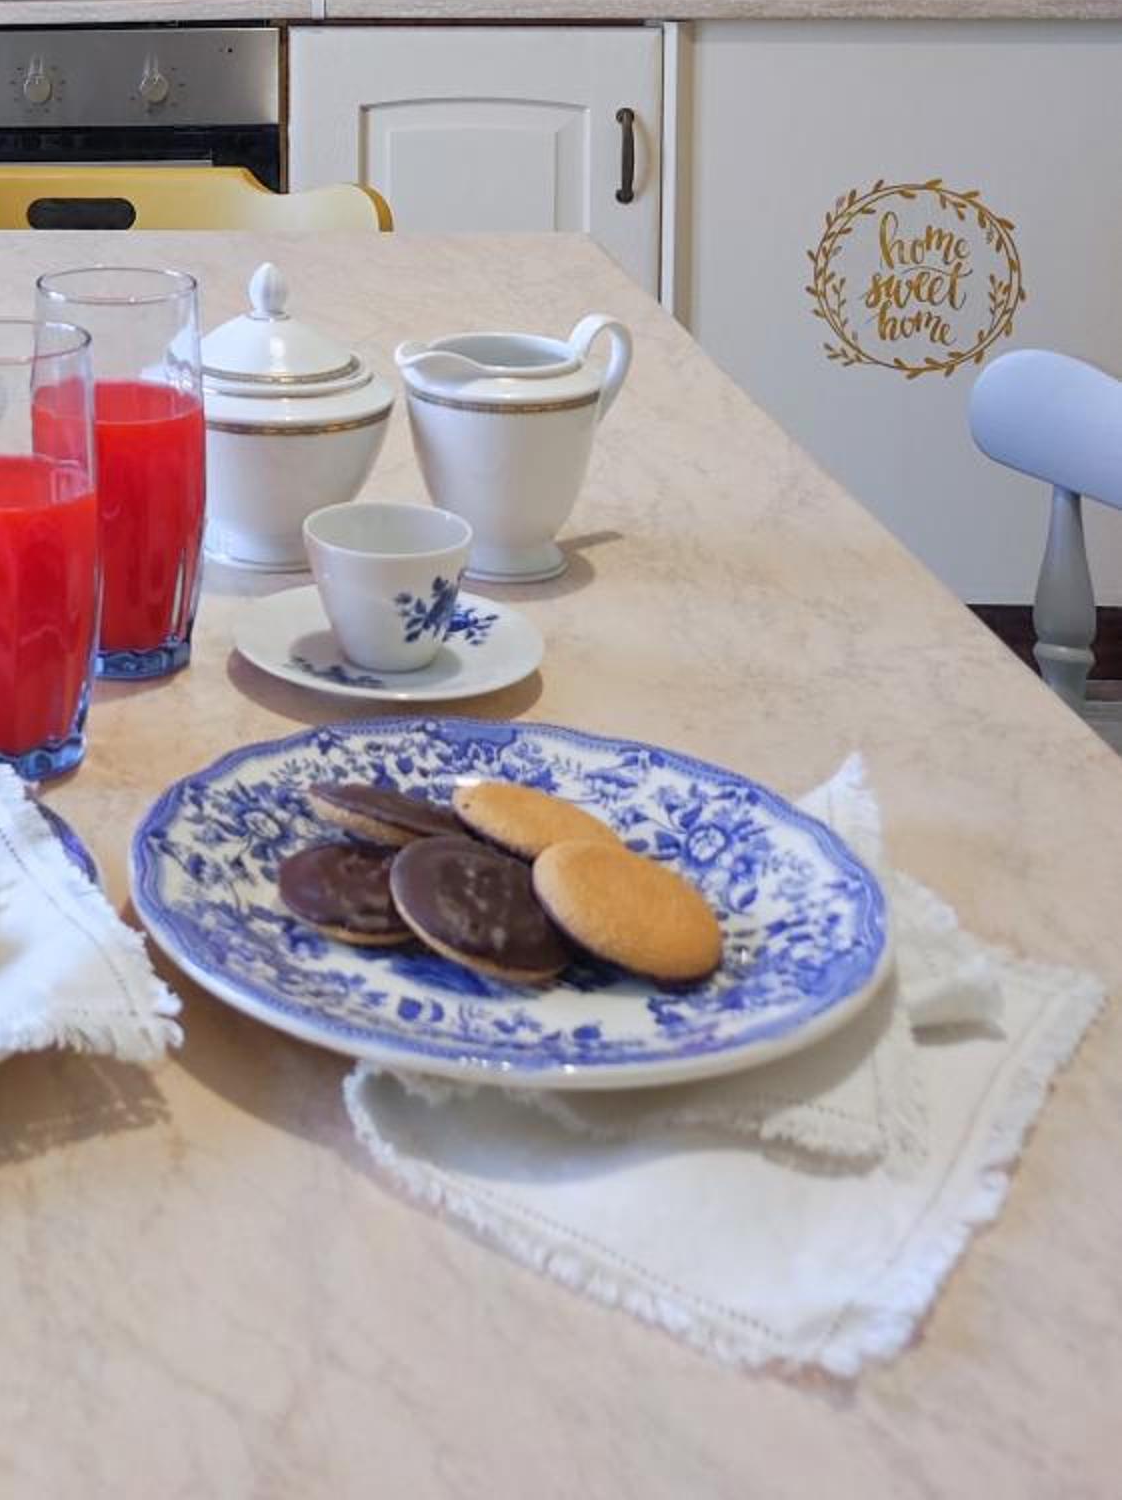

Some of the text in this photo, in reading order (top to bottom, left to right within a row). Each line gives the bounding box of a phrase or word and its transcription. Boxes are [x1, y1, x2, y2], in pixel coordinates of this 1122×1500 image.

[879, 211, 972, 269] home
[862, 262, 971, 310] sweet
[874, 301, 956, 345] home
